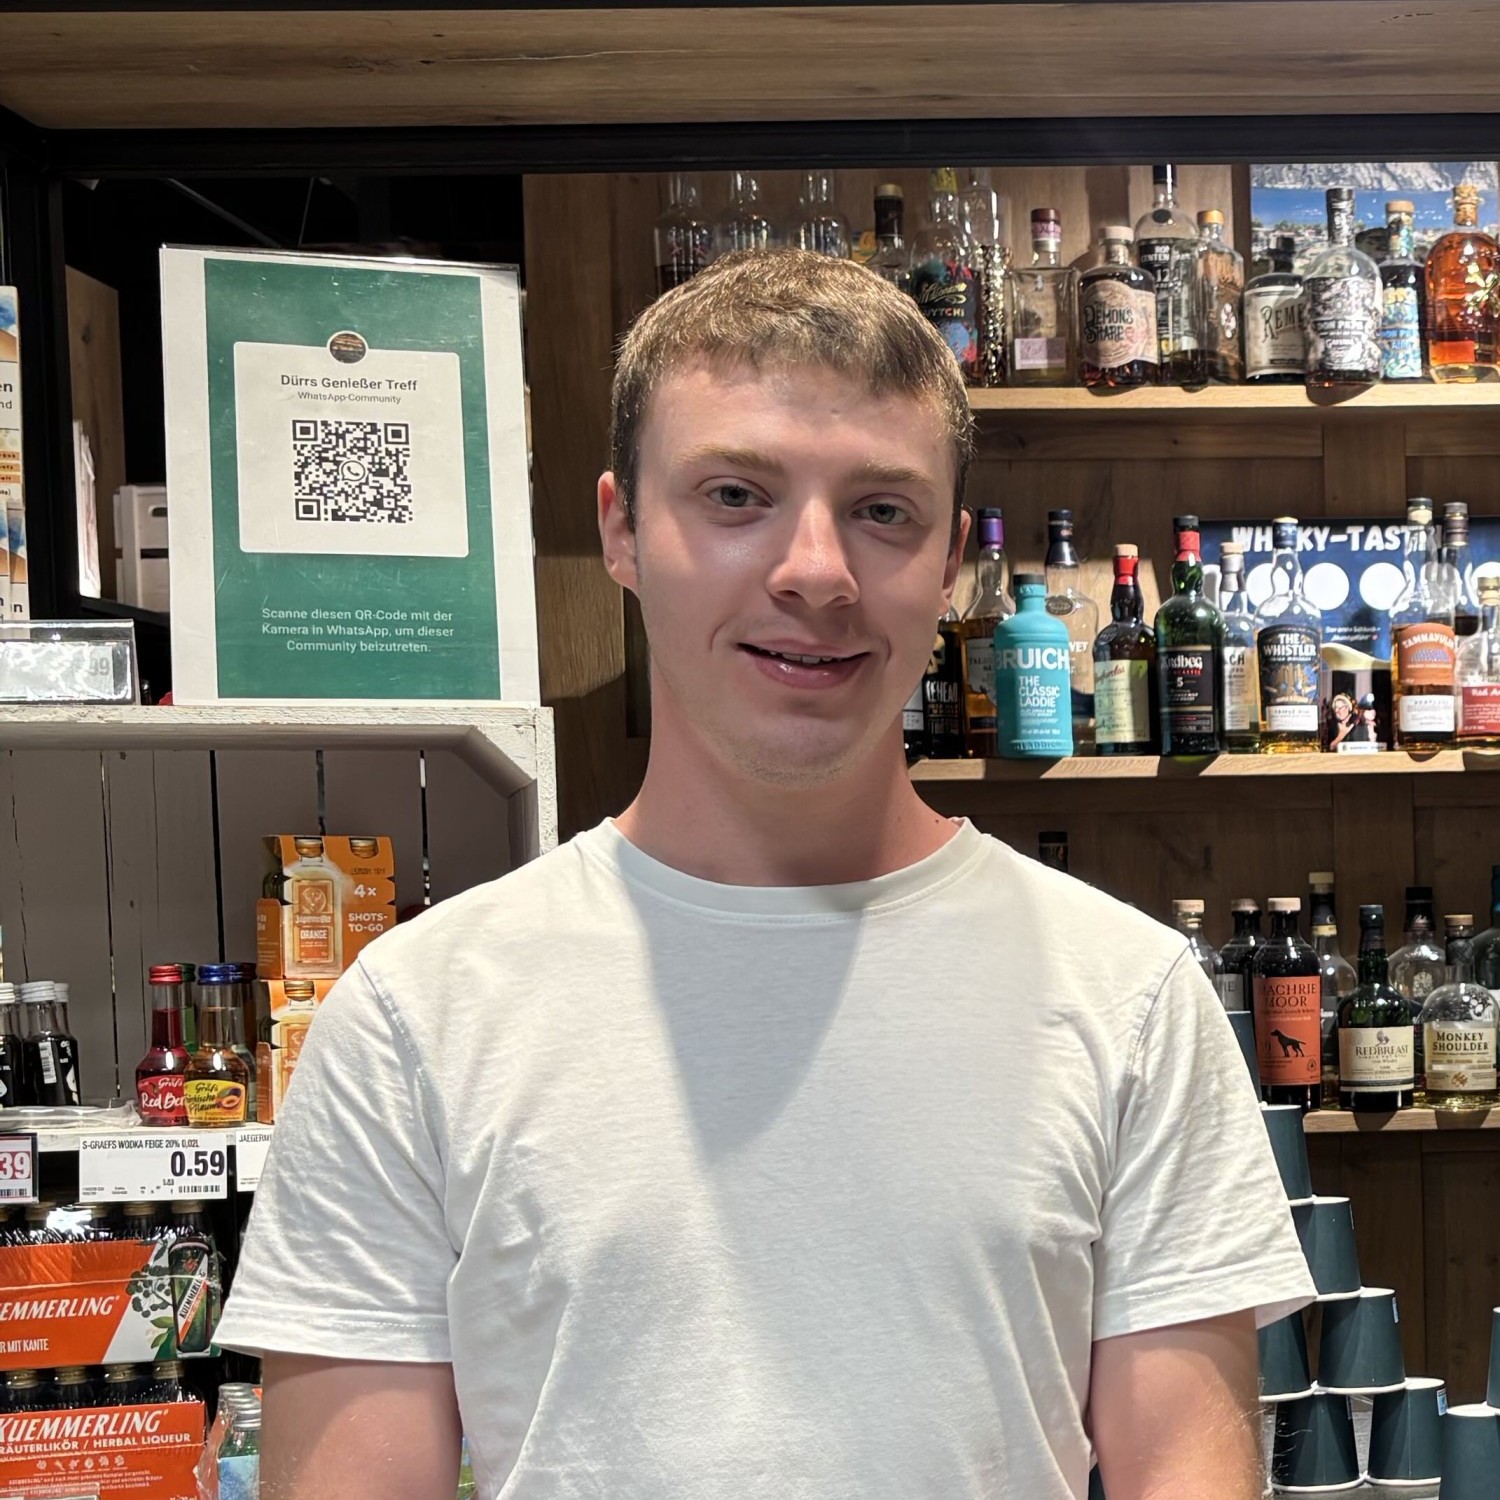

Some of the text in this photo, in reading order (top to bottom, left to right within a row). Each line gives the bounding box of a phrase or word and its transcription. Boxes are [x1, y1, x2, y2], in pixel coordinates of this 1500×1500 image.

[281, 374, 417, 391] Dürrs Genießer Treff
[262, 608, 453, 621] Scanne diesen QR-Code mit der
[262, 624, 454, 639] Kamera in WhatsApp, um dieser
[1278, 633, 1300, 644] THE
[287, 640, 431, 653] Community beizutreten.
[1263, 645, 1316, 657] WHISTLER
[1019, 676, 1040, 686] THE
[1019, 686, 1060, 697] CLASSIC
[1472, 687, 1488, 696] Red
[1019, 697, 1056, 707] LADDIE
[348, 912, 388, 922] SHOTS-
[349, 923, 383, 932] TO-GO
[300, 929, 327, 939] ORANGE
[1437, 1032, 1484, 1041] MONKEY
[1355, 1044, 1408, 1057] REDBREAST
[1433, 1042, 1489, 1051] SHOULDER
[142, 1093, 162, 1109] Red
[82, 1139, 181, 1149] S-GRAEFS WODKA FEIGE 20%
[171, 1150, 225, 1177] 0.59
[0, 1297, 115, 1321] EMMERLING
[8, 1338, 49, 1352] MIT KANTE
[0, 1410, 163, 1442] KUEMMERLING
[94, 1436, 137, 1448] HERBAL
[142, 1434, 191, 1445] LIQUEUR
